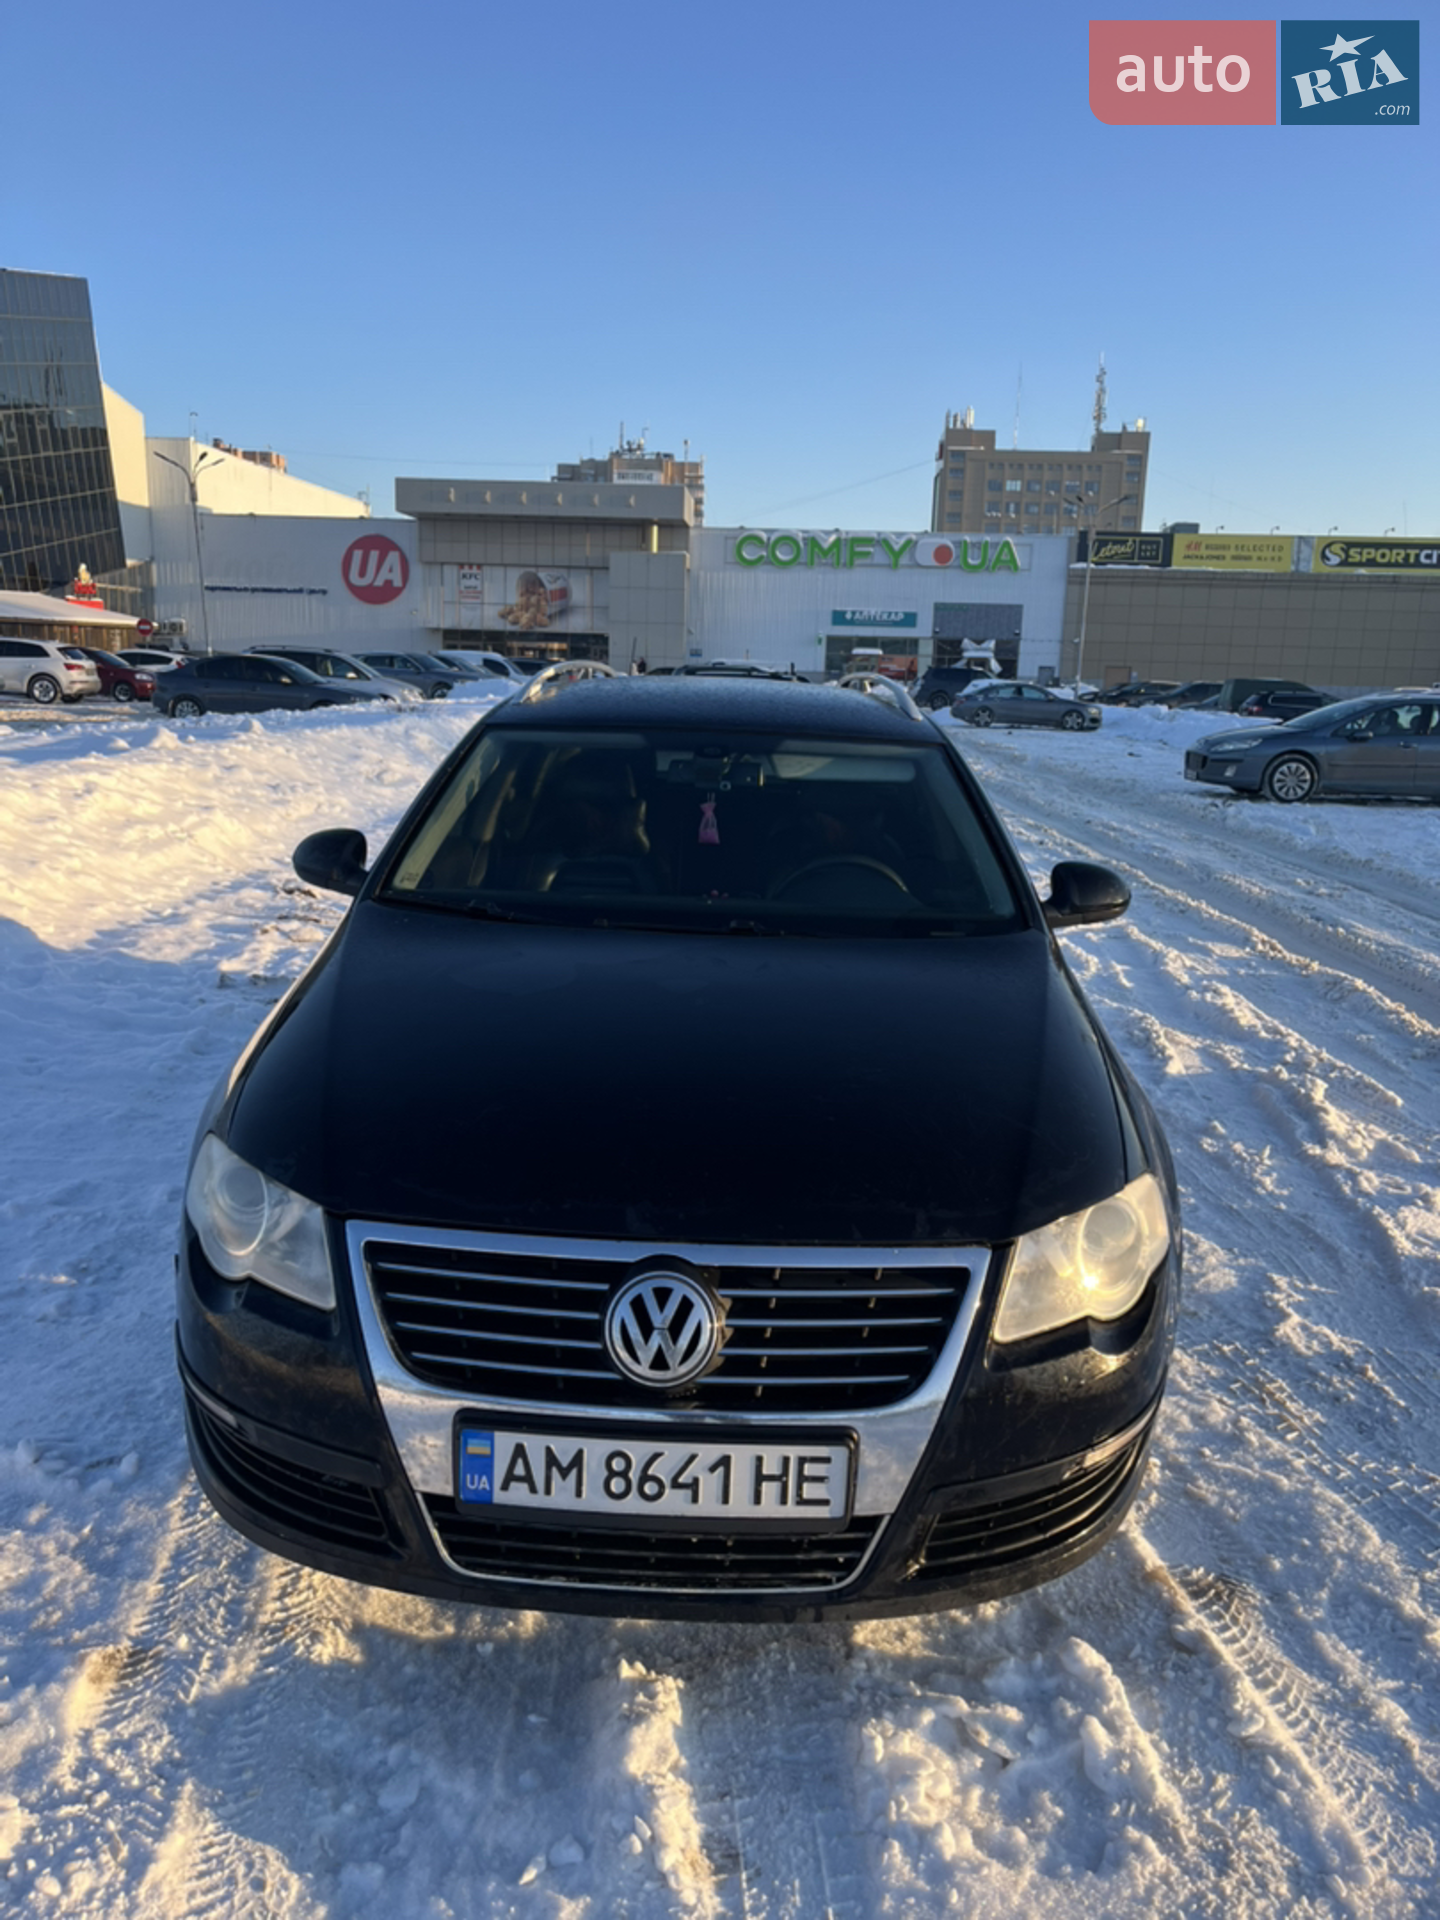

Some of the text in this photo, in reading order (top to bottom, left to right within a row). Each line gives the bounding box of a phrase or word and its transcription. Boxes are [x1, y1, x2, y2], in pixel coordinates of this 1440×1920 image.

[735, 530, 1021, 573] COMFY UA
[1234, 543, 1284, 552] SELECTED
[348, 548, 403, 588] UA
[461, 572, 481, 581] KFC
[466, 1473, 490, 1492] UA
[499, 1442, 832, 1507] AM 8641 HE
